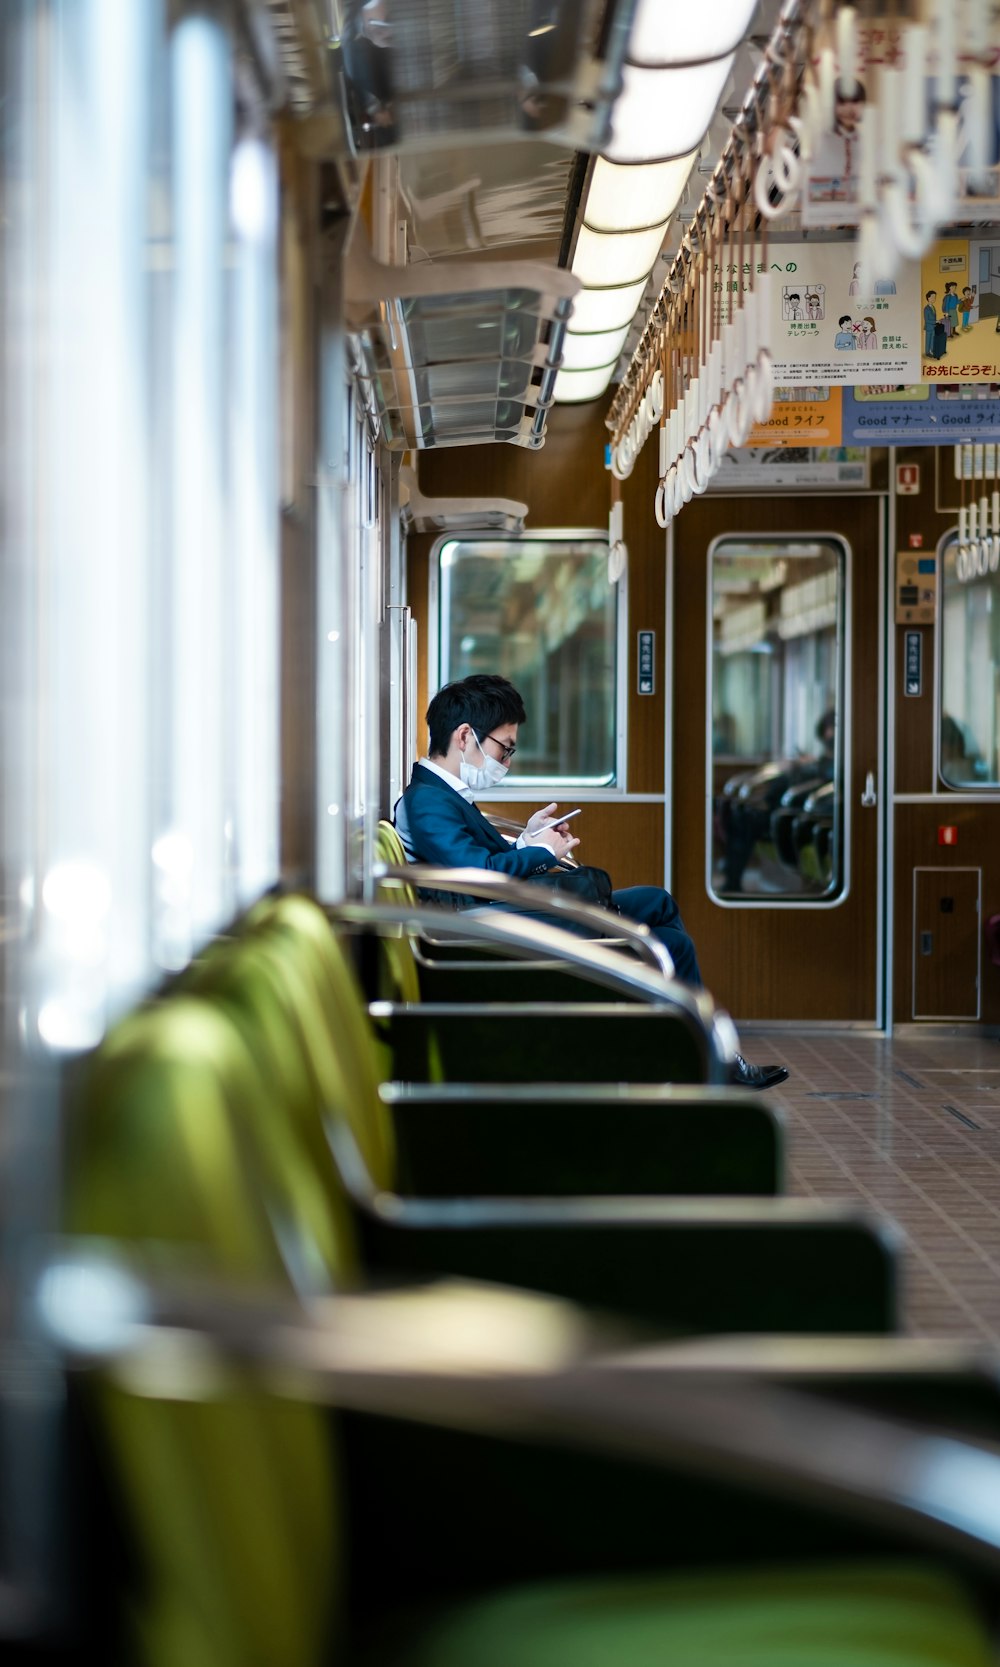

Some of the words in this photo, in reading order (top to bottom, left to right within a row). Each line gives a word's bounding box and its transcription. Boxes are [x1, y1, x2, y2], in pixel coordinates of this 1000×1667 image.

[713, 262, 797, 274] みなさまへの
[713, 281, 752, 293] お願い
[794, 415, 825, 426] ライフ
[858, 415, 887, 426] Good
[891, 414, 923, 425] マナー
[941, 413, 971, 424] Good
